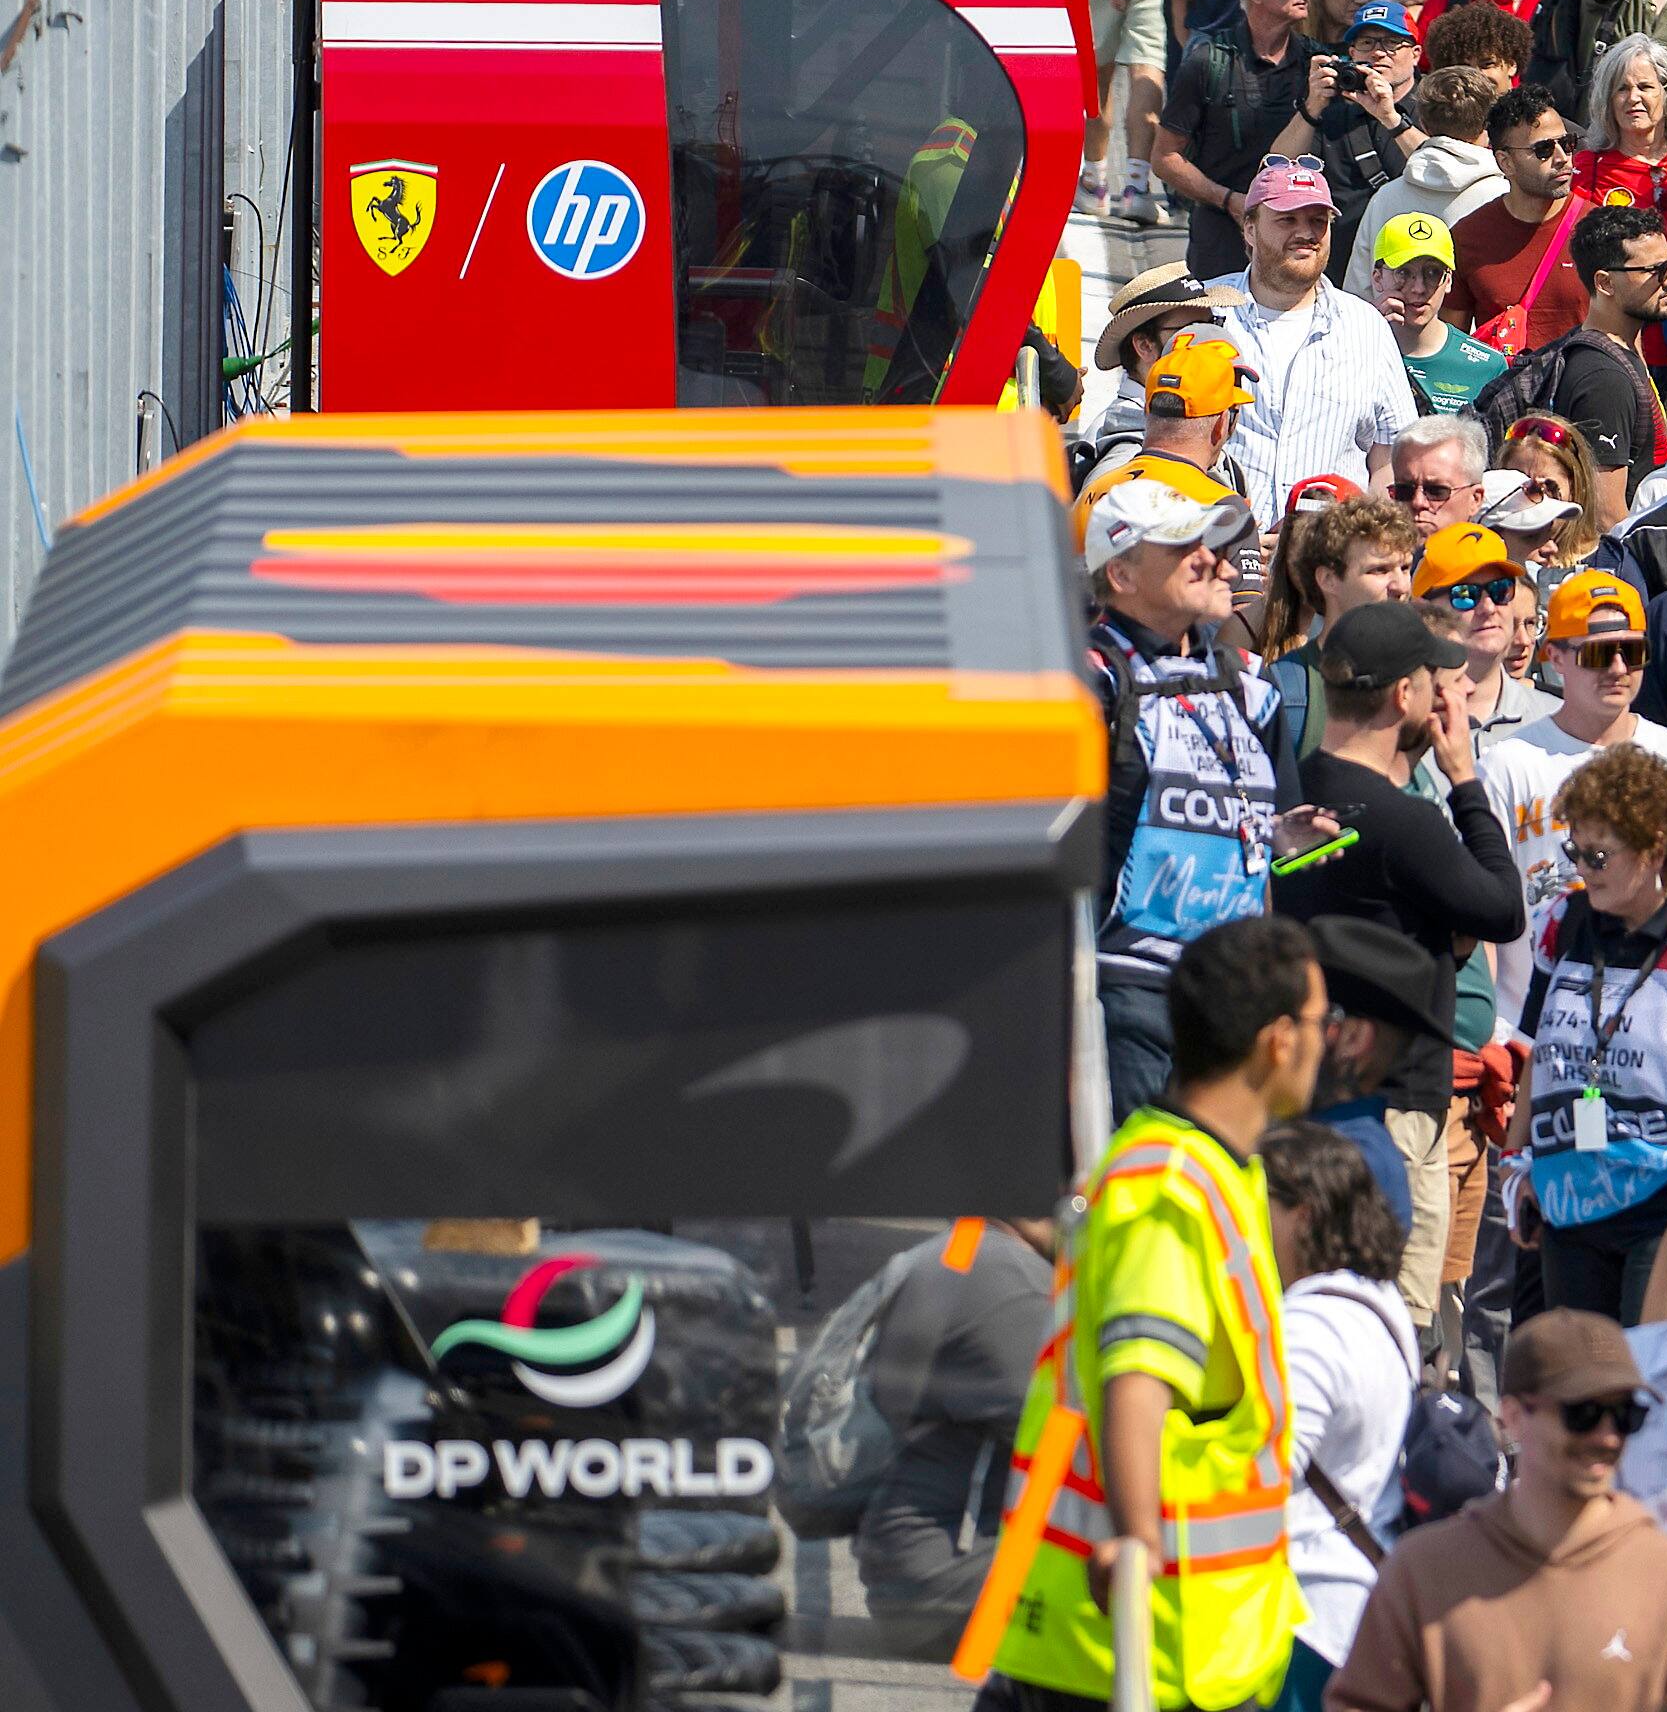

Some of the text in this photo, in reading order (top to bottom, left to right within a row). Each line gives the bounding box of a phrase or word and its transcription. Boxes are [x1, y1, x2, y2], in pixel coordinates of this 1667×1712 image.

[542, 162, 632, 276] hp
[384, 1439, 776, 1499] DP WORLD
